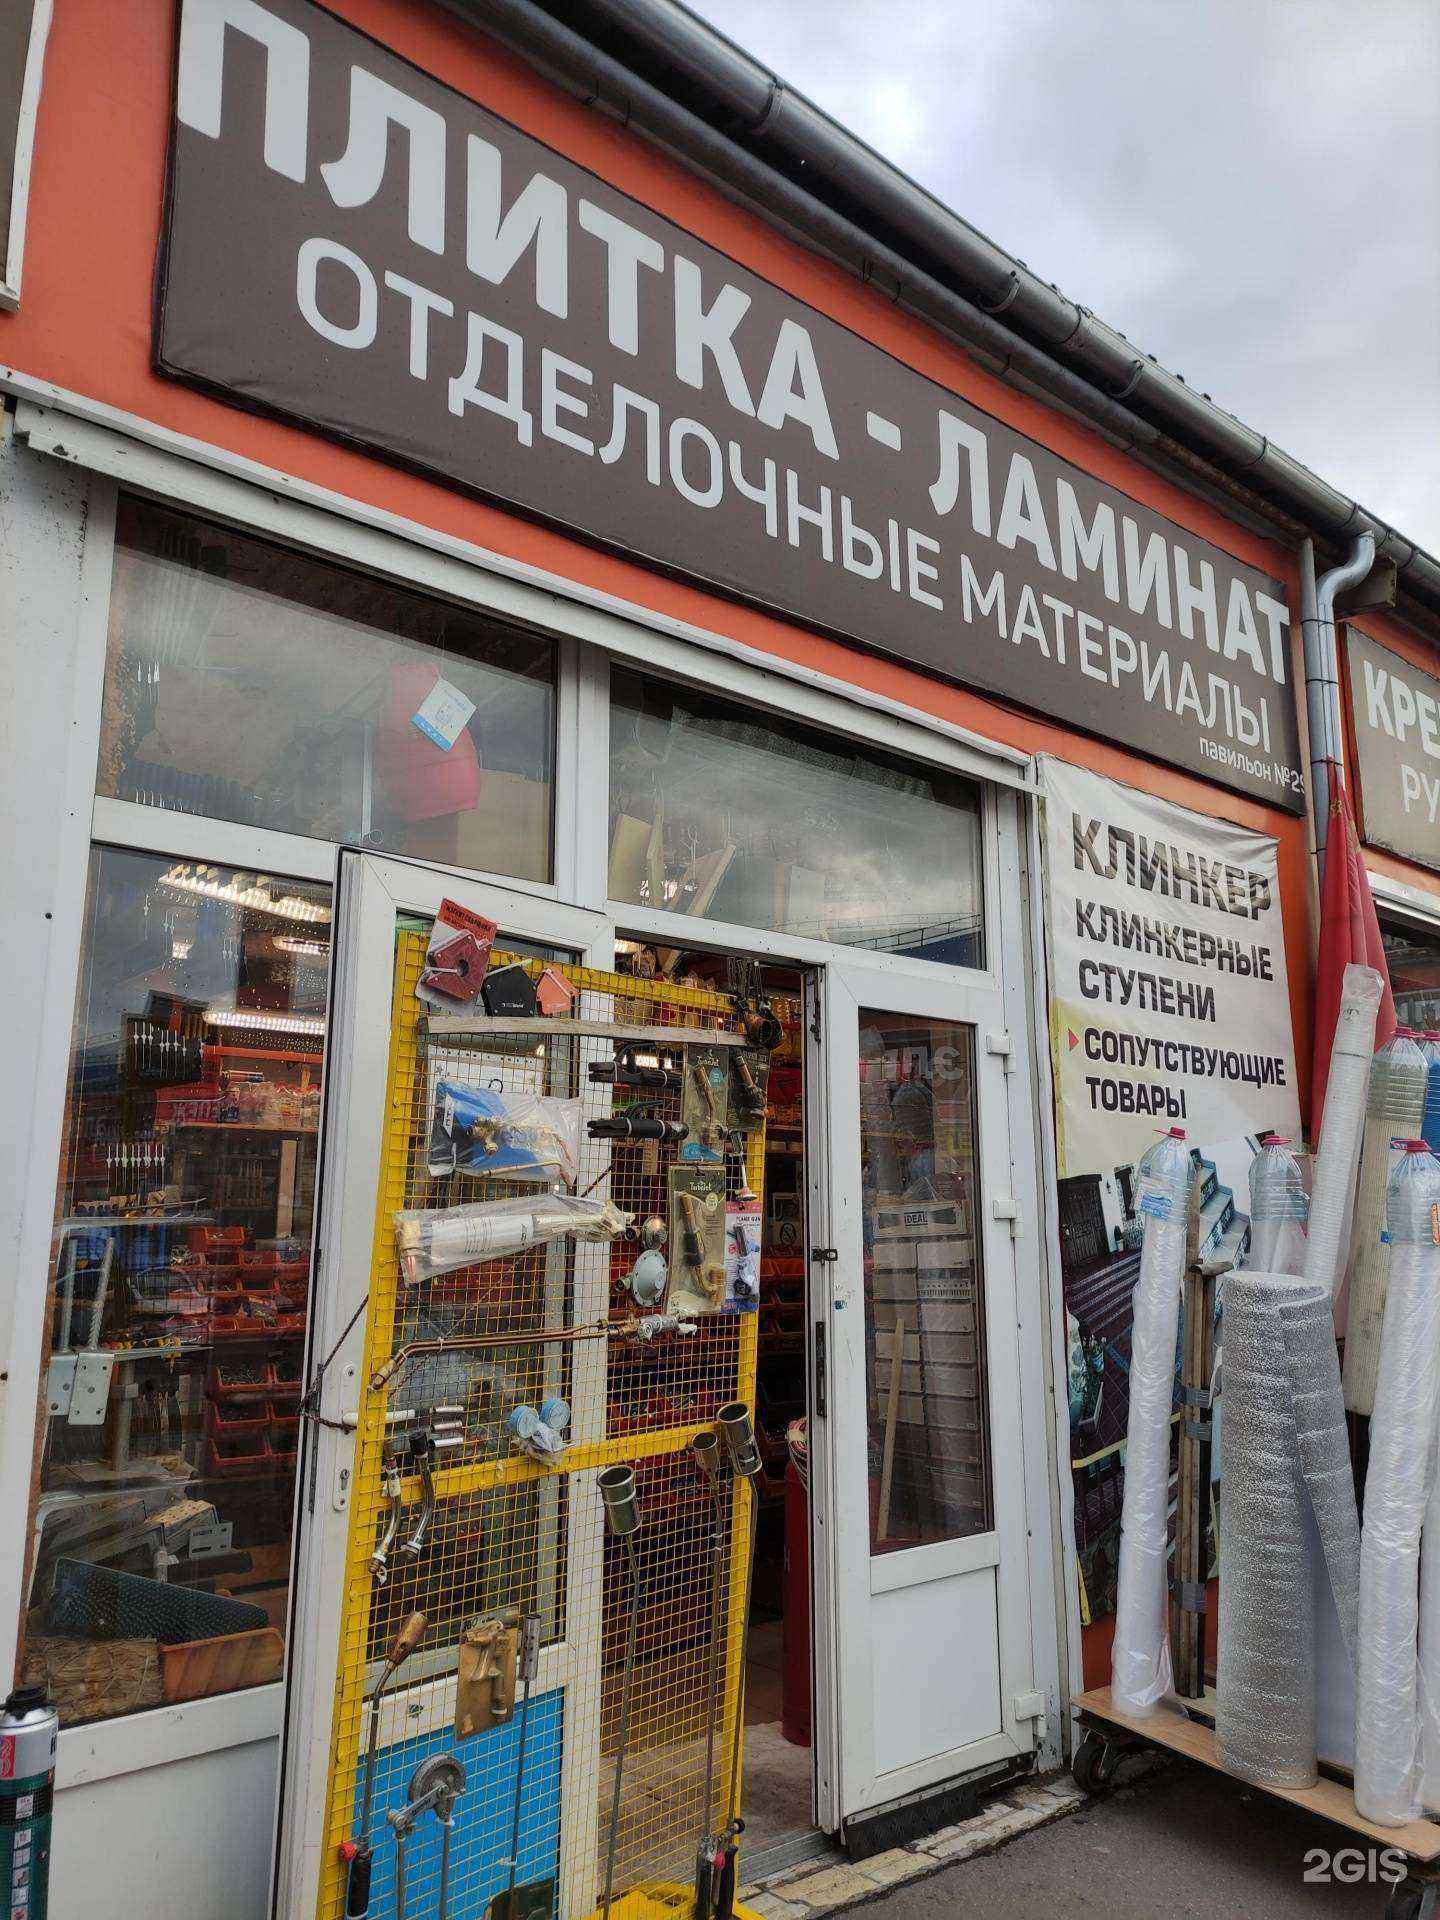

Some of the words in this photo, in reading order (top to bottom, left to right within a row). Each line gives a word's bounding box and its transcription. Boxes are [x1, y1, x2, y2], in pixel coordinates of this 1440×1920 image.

[178, 0, 839, 459] ПЛИТКА
[929, 410, 1289, 684] ЛАМИНАТ
[297, 237, 943, 611] ОТДЕЛОЧНЫЕ
[961, 554, 1271, 753] МАТЕРИАЛЫ
[1363, 659, 1440, 760] КРЕ
[1200, 737, 1271, 782] павильон
[1072, 813, 1272, 921] КЛИНКЕР
[1076, 898, 1274, 982] КЛИНКЕРНЫЕ
[1079, 958, 1217, 1023] СТУПЕНИ
[1085, 1027, 1287, 1090] СОПУТСТВУЮЩИЕ
[1086, 1077, 1187, 1120] ТОВАРЫ
[904, 1212, 929, 1224] IDEAL
